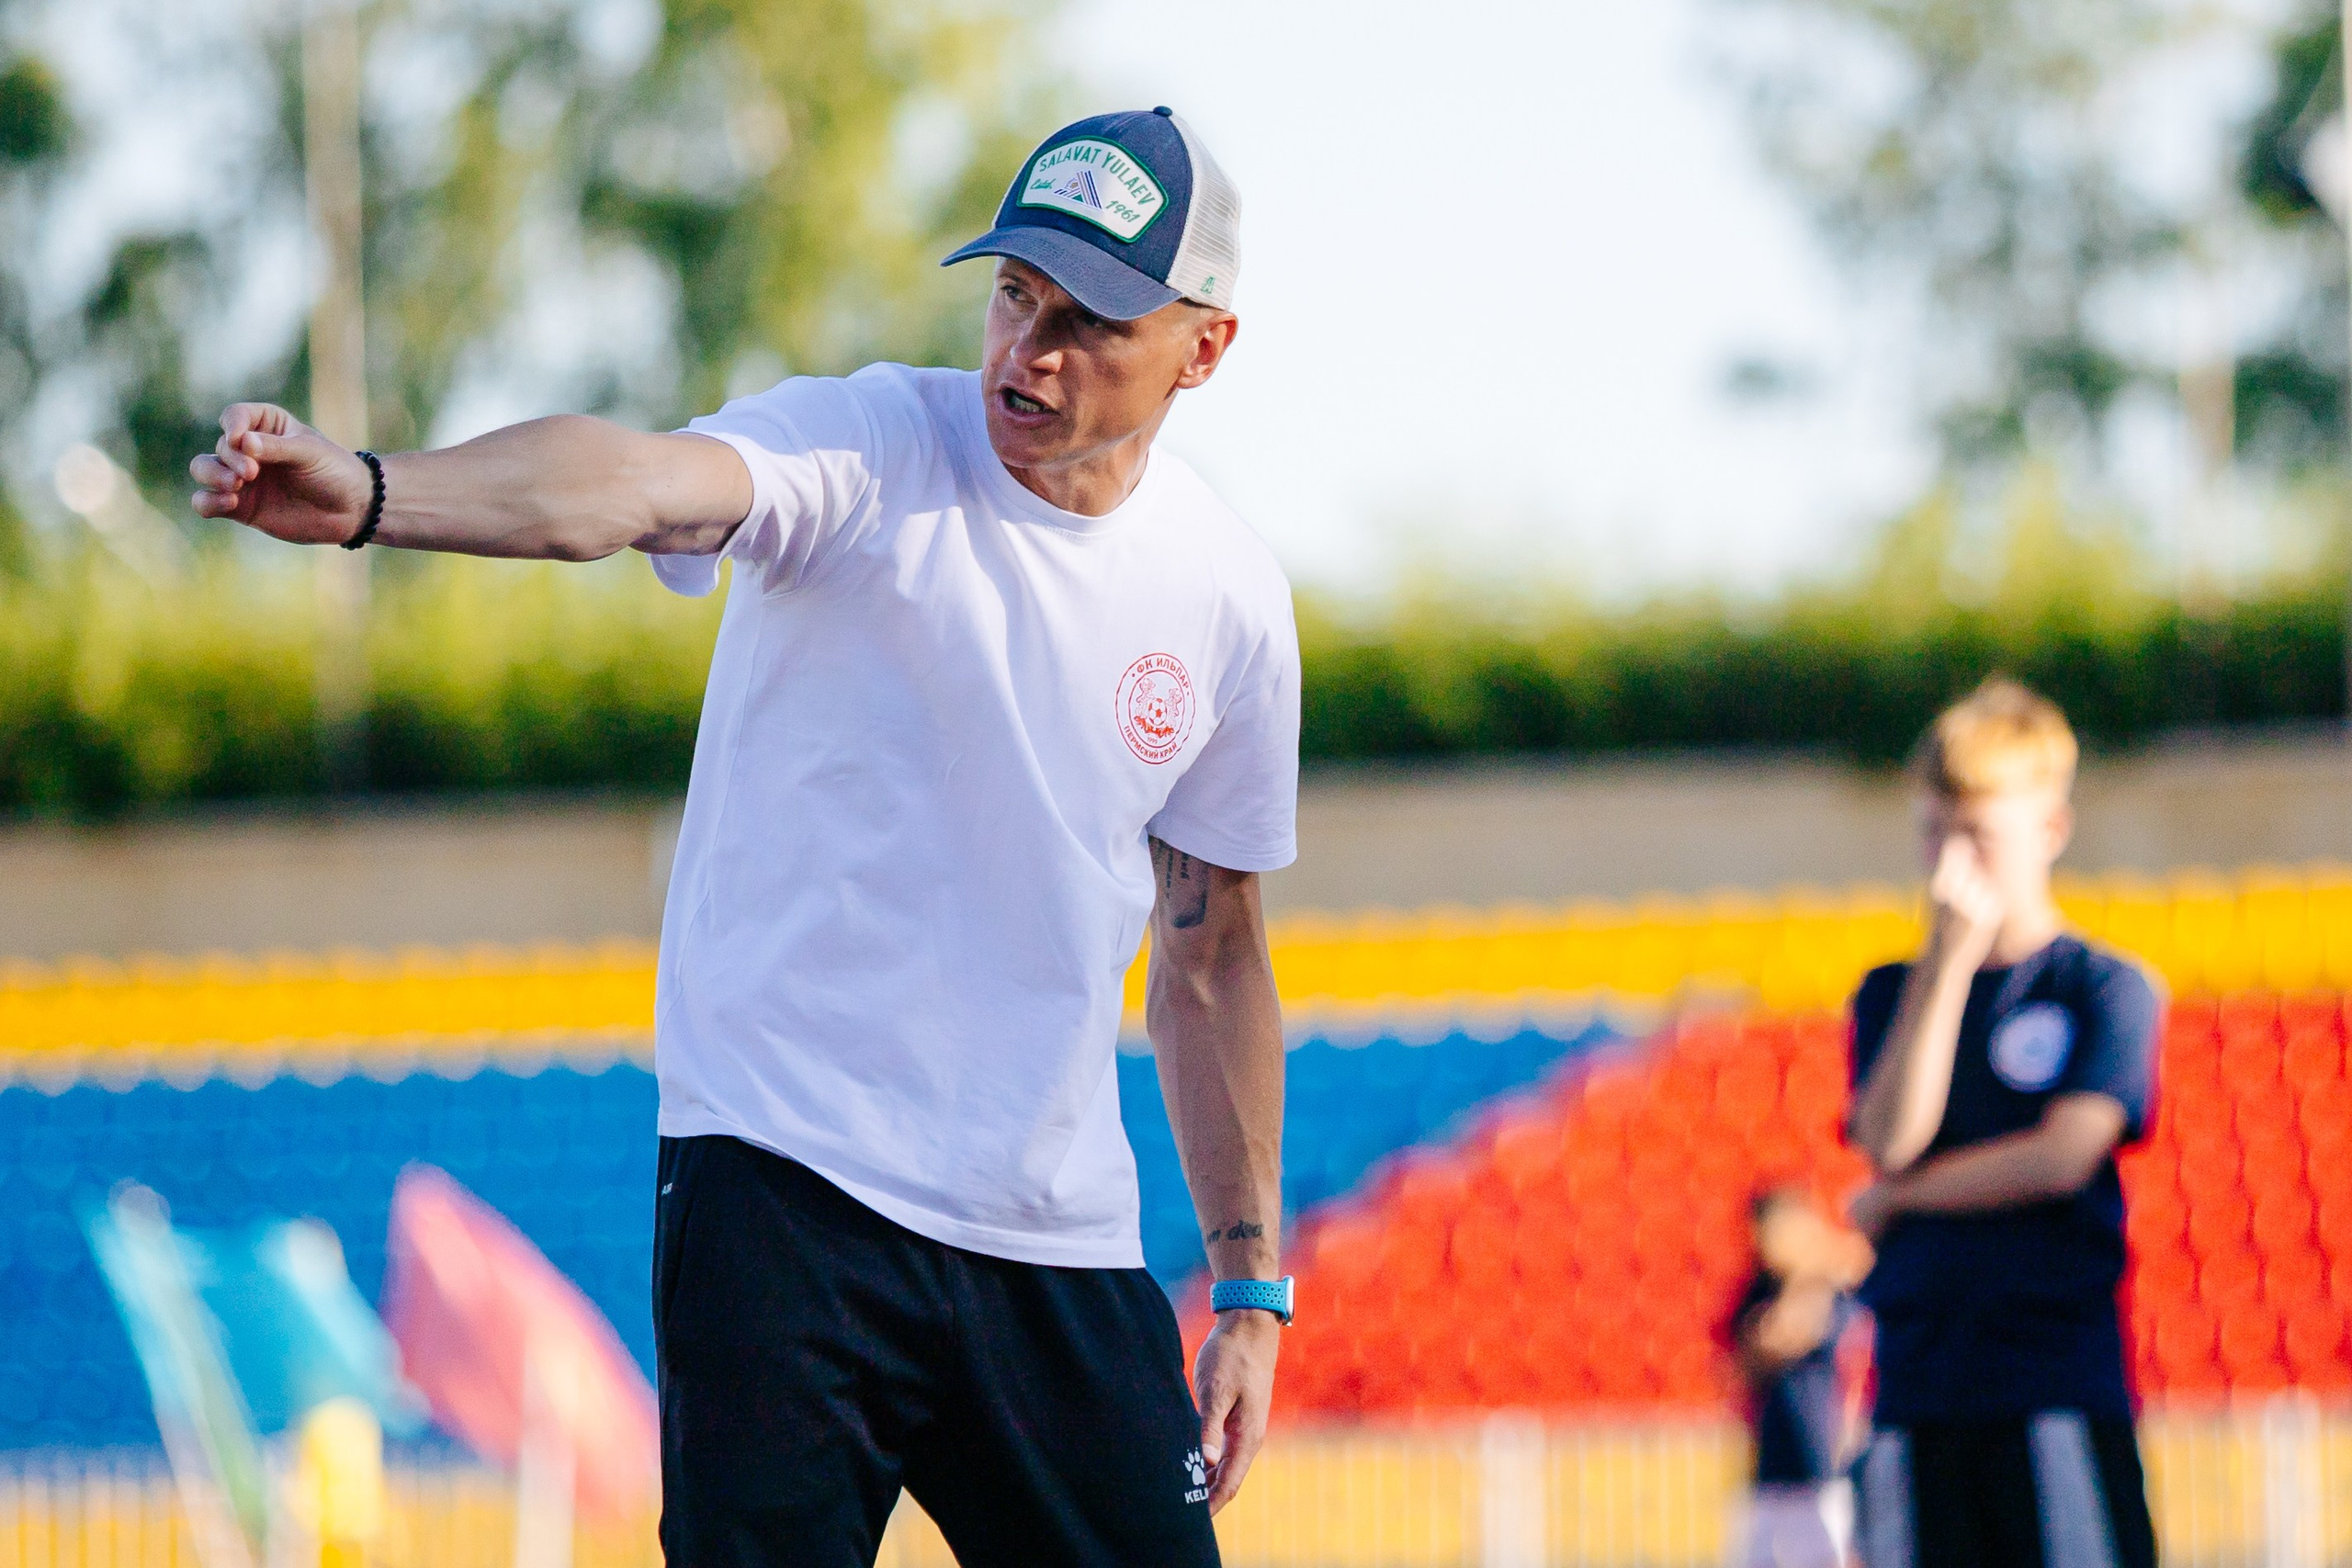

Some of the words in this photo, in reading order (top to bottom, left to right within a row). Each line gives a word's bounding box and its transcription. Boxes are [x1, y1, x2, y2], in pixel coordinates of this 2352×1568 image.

[1039, 145, 1102, 173] SALAVAT
[1101, 152, 1156, 206] YULAEV
[1105, 199, 1141, 223] 1961
[1136, 659, 1153, 673] ФК
